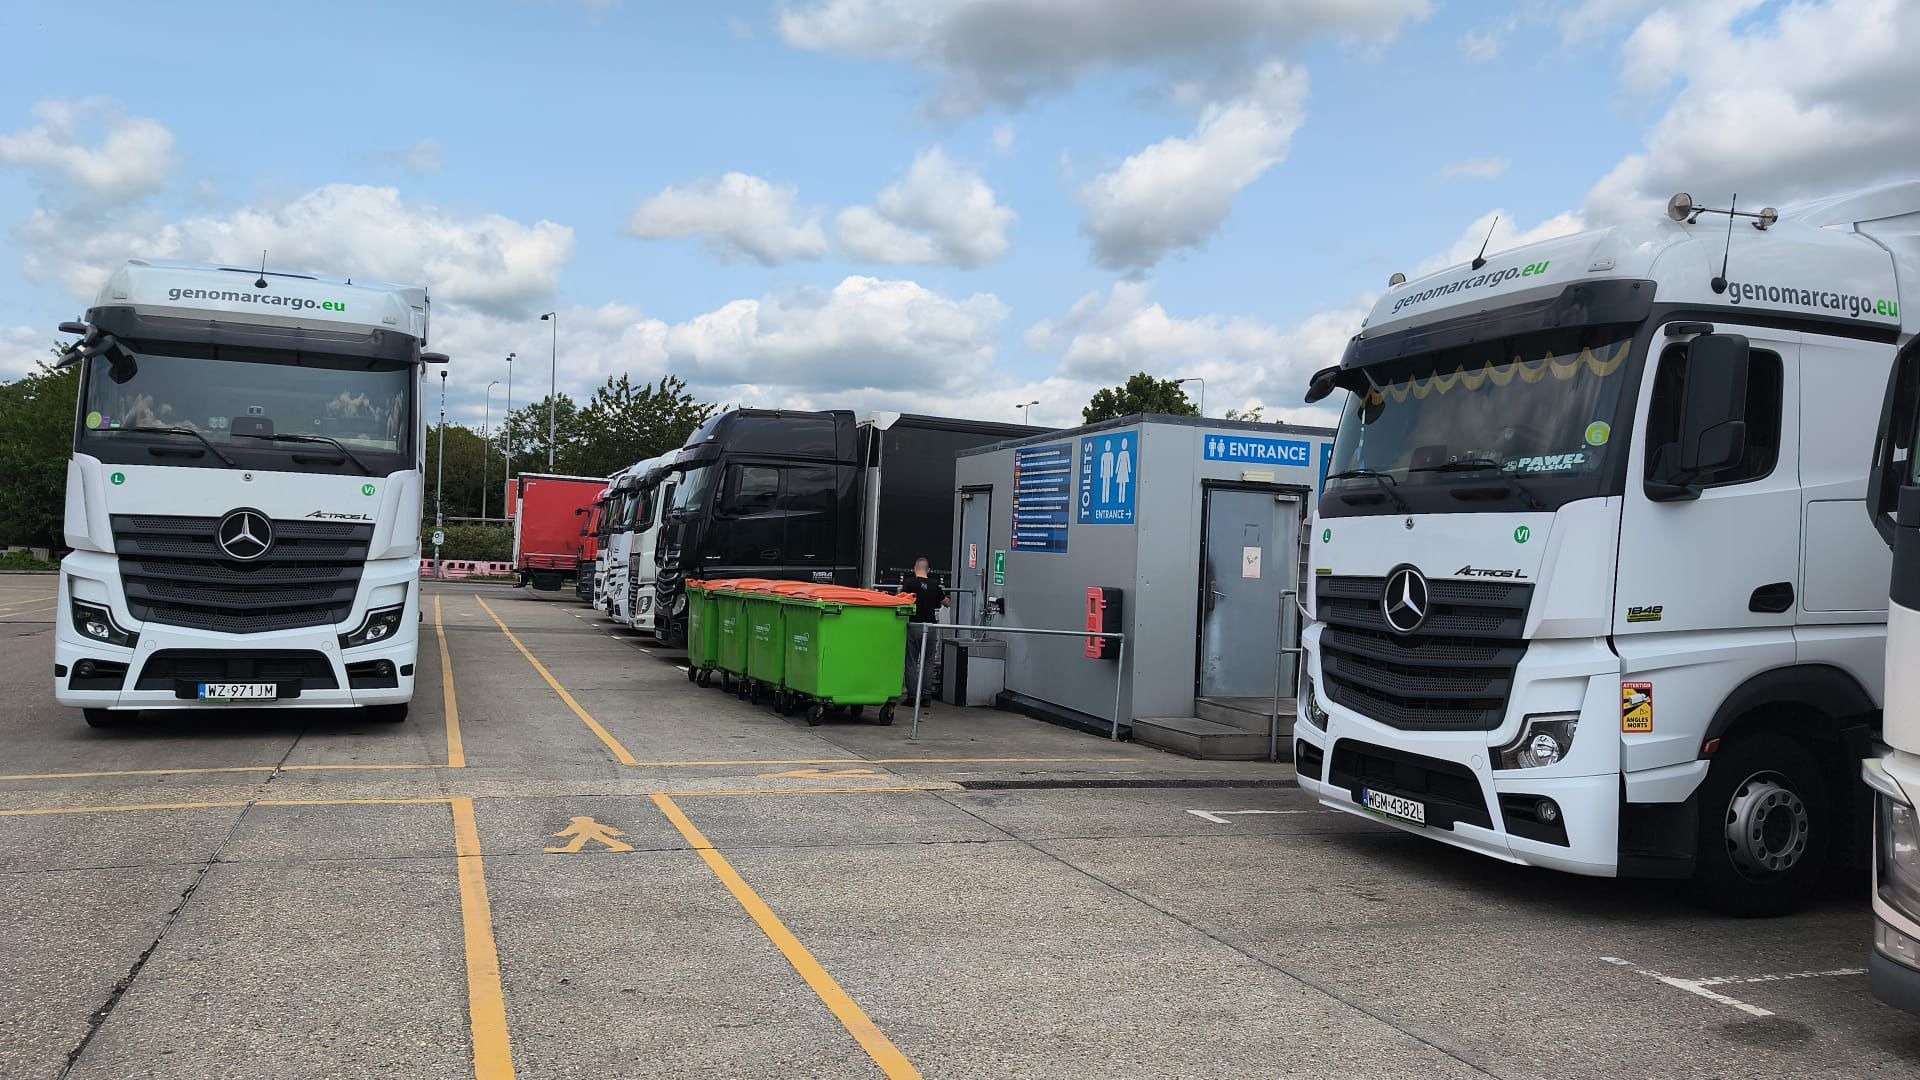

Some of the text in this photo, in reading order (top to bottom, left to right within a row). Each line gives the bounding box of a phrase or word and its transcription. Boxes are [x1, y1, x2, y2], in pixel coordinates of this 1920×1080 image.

[1392, 260, 1550, 315] genomarcargo.eu
[168, 287, 346, 312] genomarcargo.eu
[1728, 281, 1898, 318] genomarcargo.eu
[1229, 442, 1306, 461] ENTRANCE
[115, 475, 122, 483] L
[1081, 442, 1093, 519] TOILETS
[365, 485, 374, 494] VI
[362, 513, 373, 521] L
[1096, 509, 1125, 519] ENTRANCE
[1517, 529, 1529, 541] VI
[1514, 569, 1528, 579] L
[208, 685, 273, 697] WZ 971JM
[1368, 792, 1424, 820] WGM 4382L
